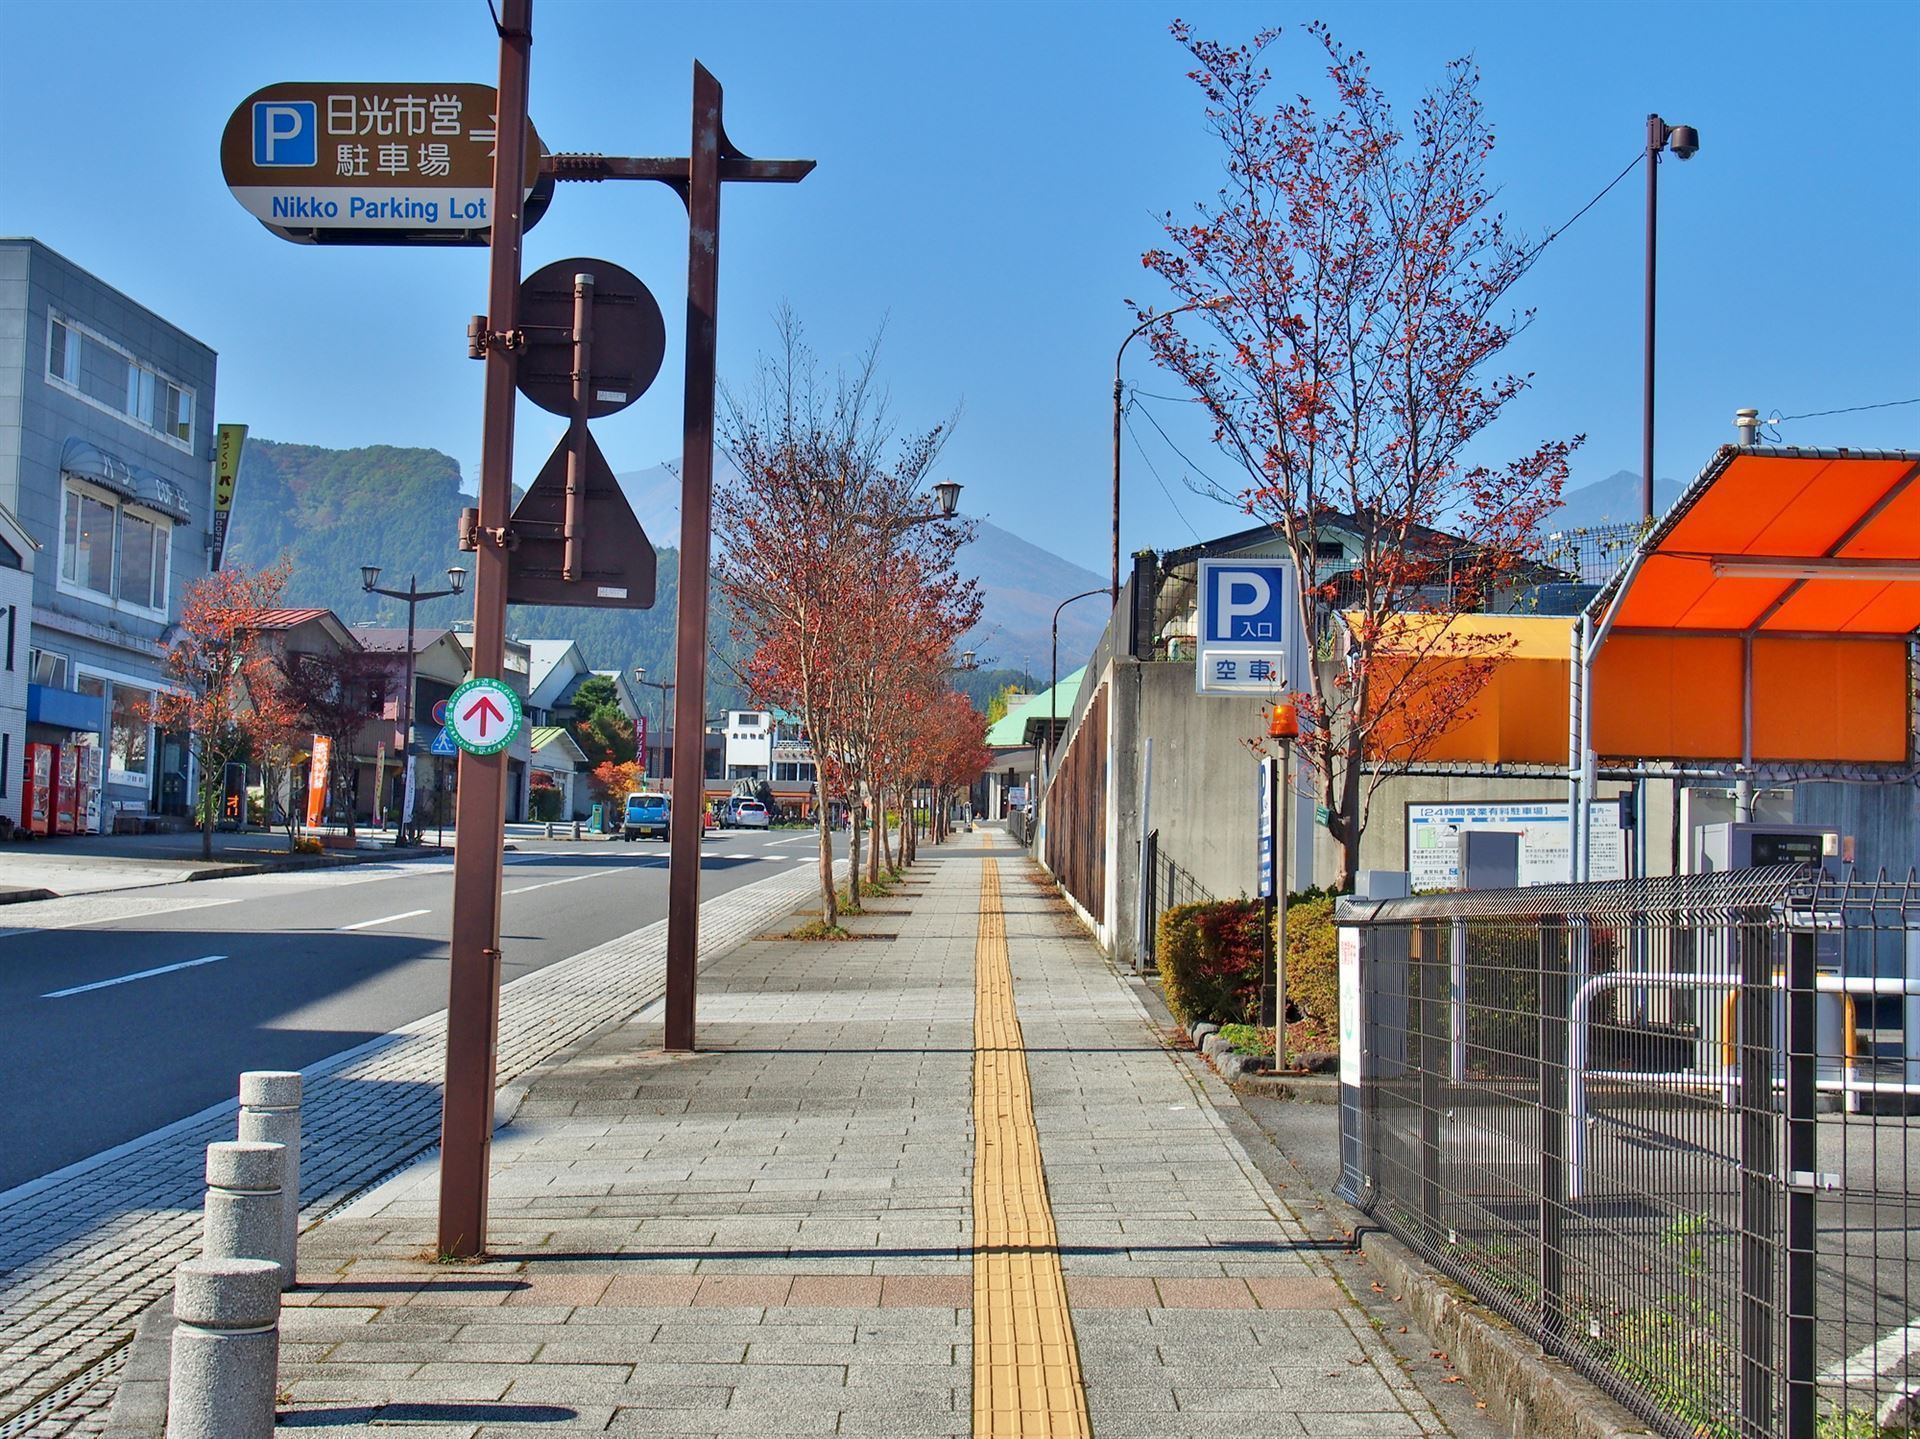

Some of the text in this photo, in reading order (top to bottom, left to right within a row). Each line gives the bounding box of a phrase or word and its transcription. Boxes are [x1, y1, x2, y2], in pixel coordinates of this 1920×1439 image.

[327, 94, 462, 137] 日光市営
[265, 107, 303, 162] P
[336, 143, 451, 177] 駐車場
[272, 196, 487, 223] Nikko Parking Lot
[155, 479, 190, 513] COFEE
[214, 520, 223, 552] COFFEE
[1217, 571, 1271, 639] P
[1240, 621, 1272, 638] 入口
[1216, 659, 1271, 681] 空車
